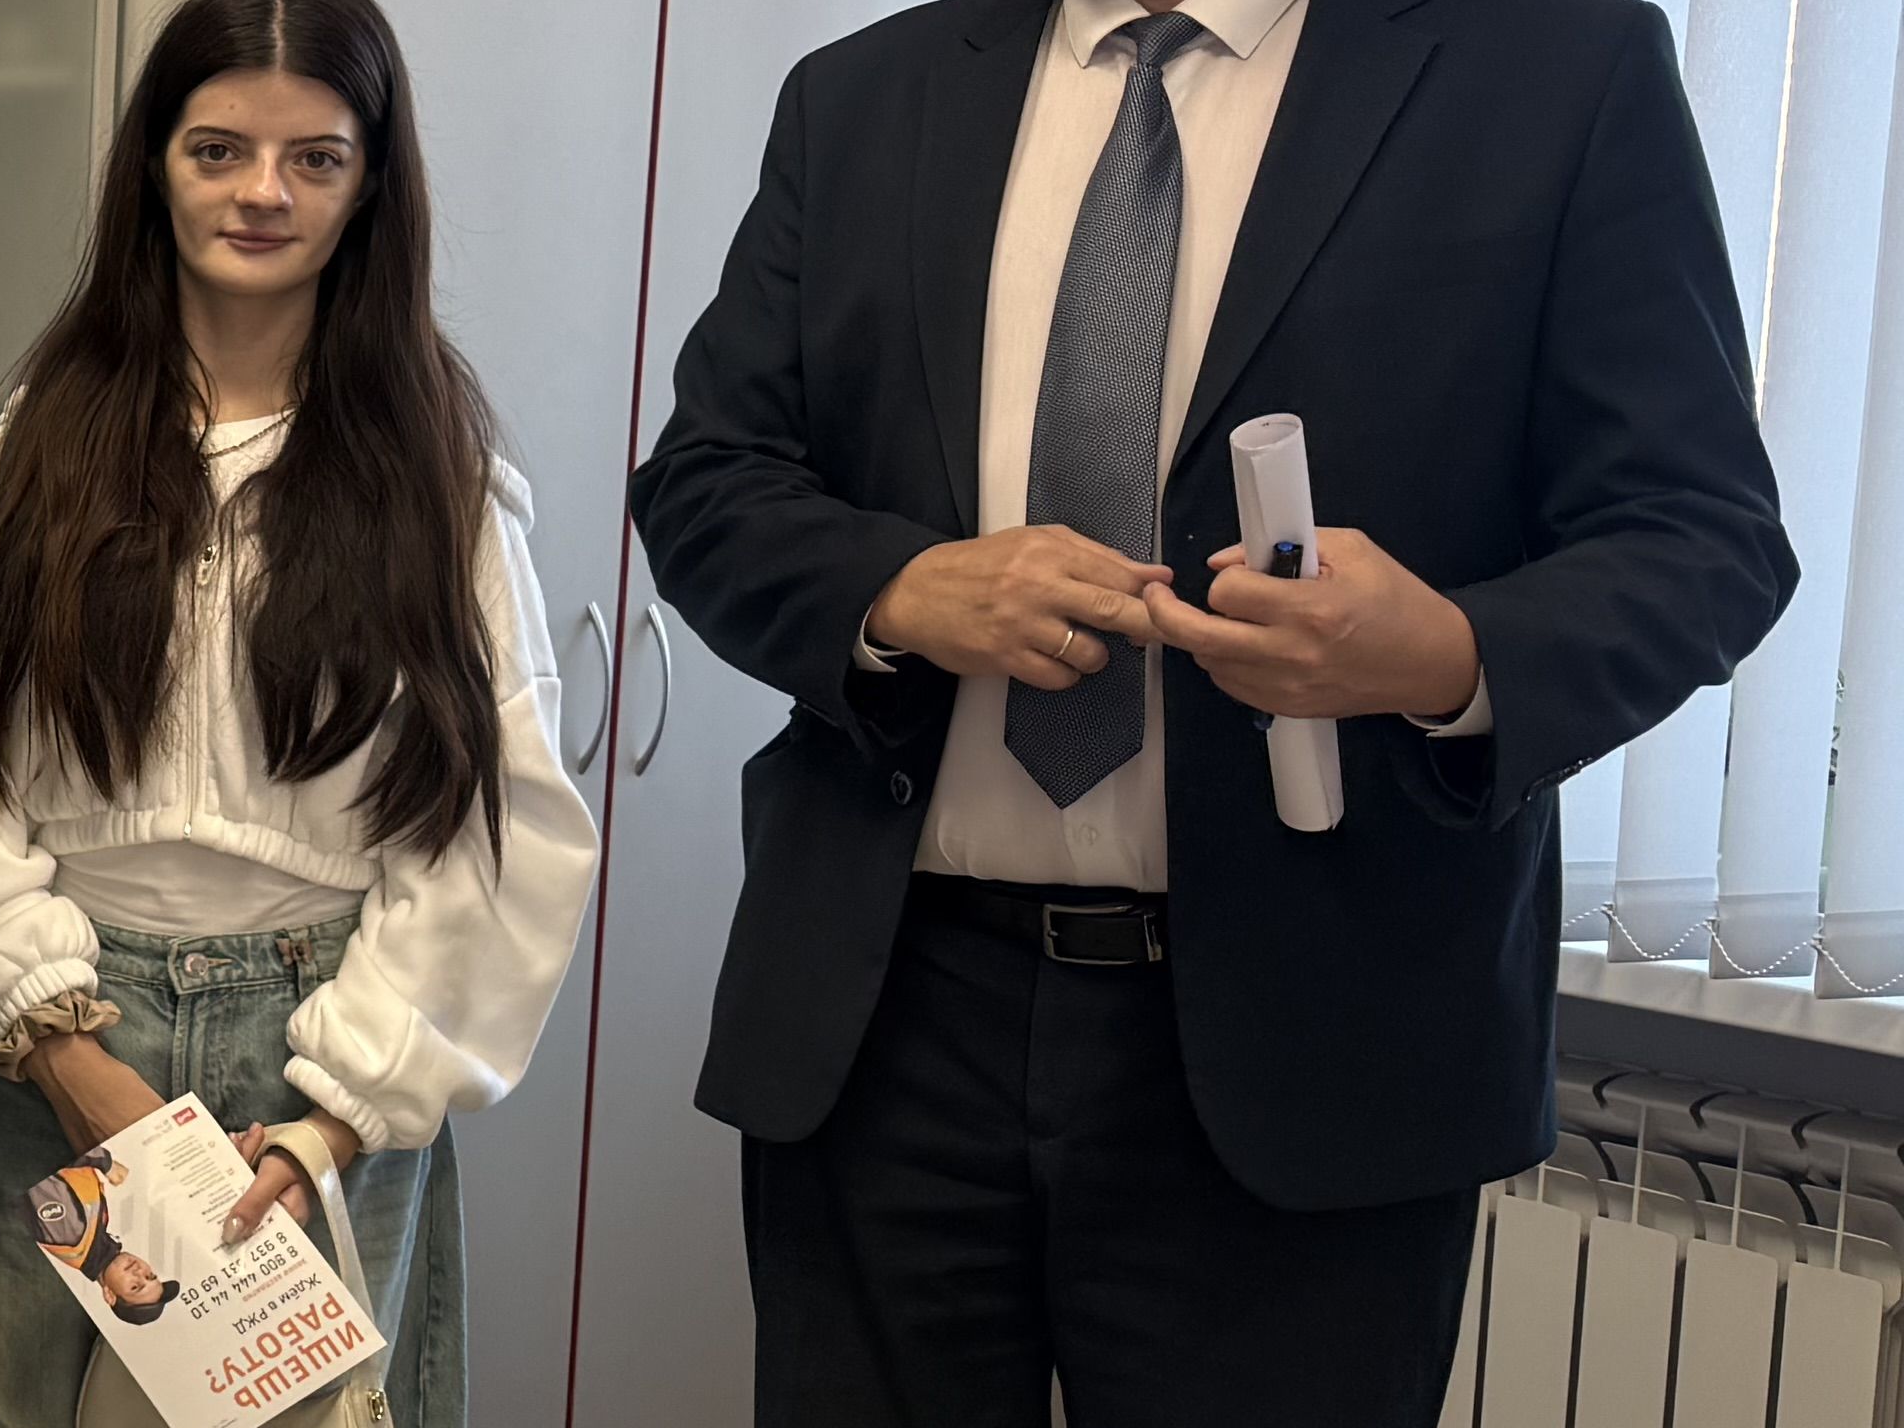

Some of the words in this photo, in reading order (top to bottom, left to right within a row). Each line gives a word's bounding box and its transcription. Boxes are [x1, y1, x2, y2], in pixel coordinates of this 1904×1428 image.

[275, 1231, 287, 1243] 8
[250, 1239, 274, 1262] 937
[286, 1245, 298, 1257] 8
[200, 1275, 217, 1292] 69
[231, 1272, 256, 1293] 444
[180, 1287, 198, 1305] 03
[210, 1290, 228, 1306] 44
[267, 1300, 277, 1310] в
[190, 1301, 209, 1319] 10
[232, 1308, 268, 1334] РЖД
[204, 1291, 344, 1392] РАБОТУ?
[232, 1318, 364, 1410] ИЩЕШЬ
